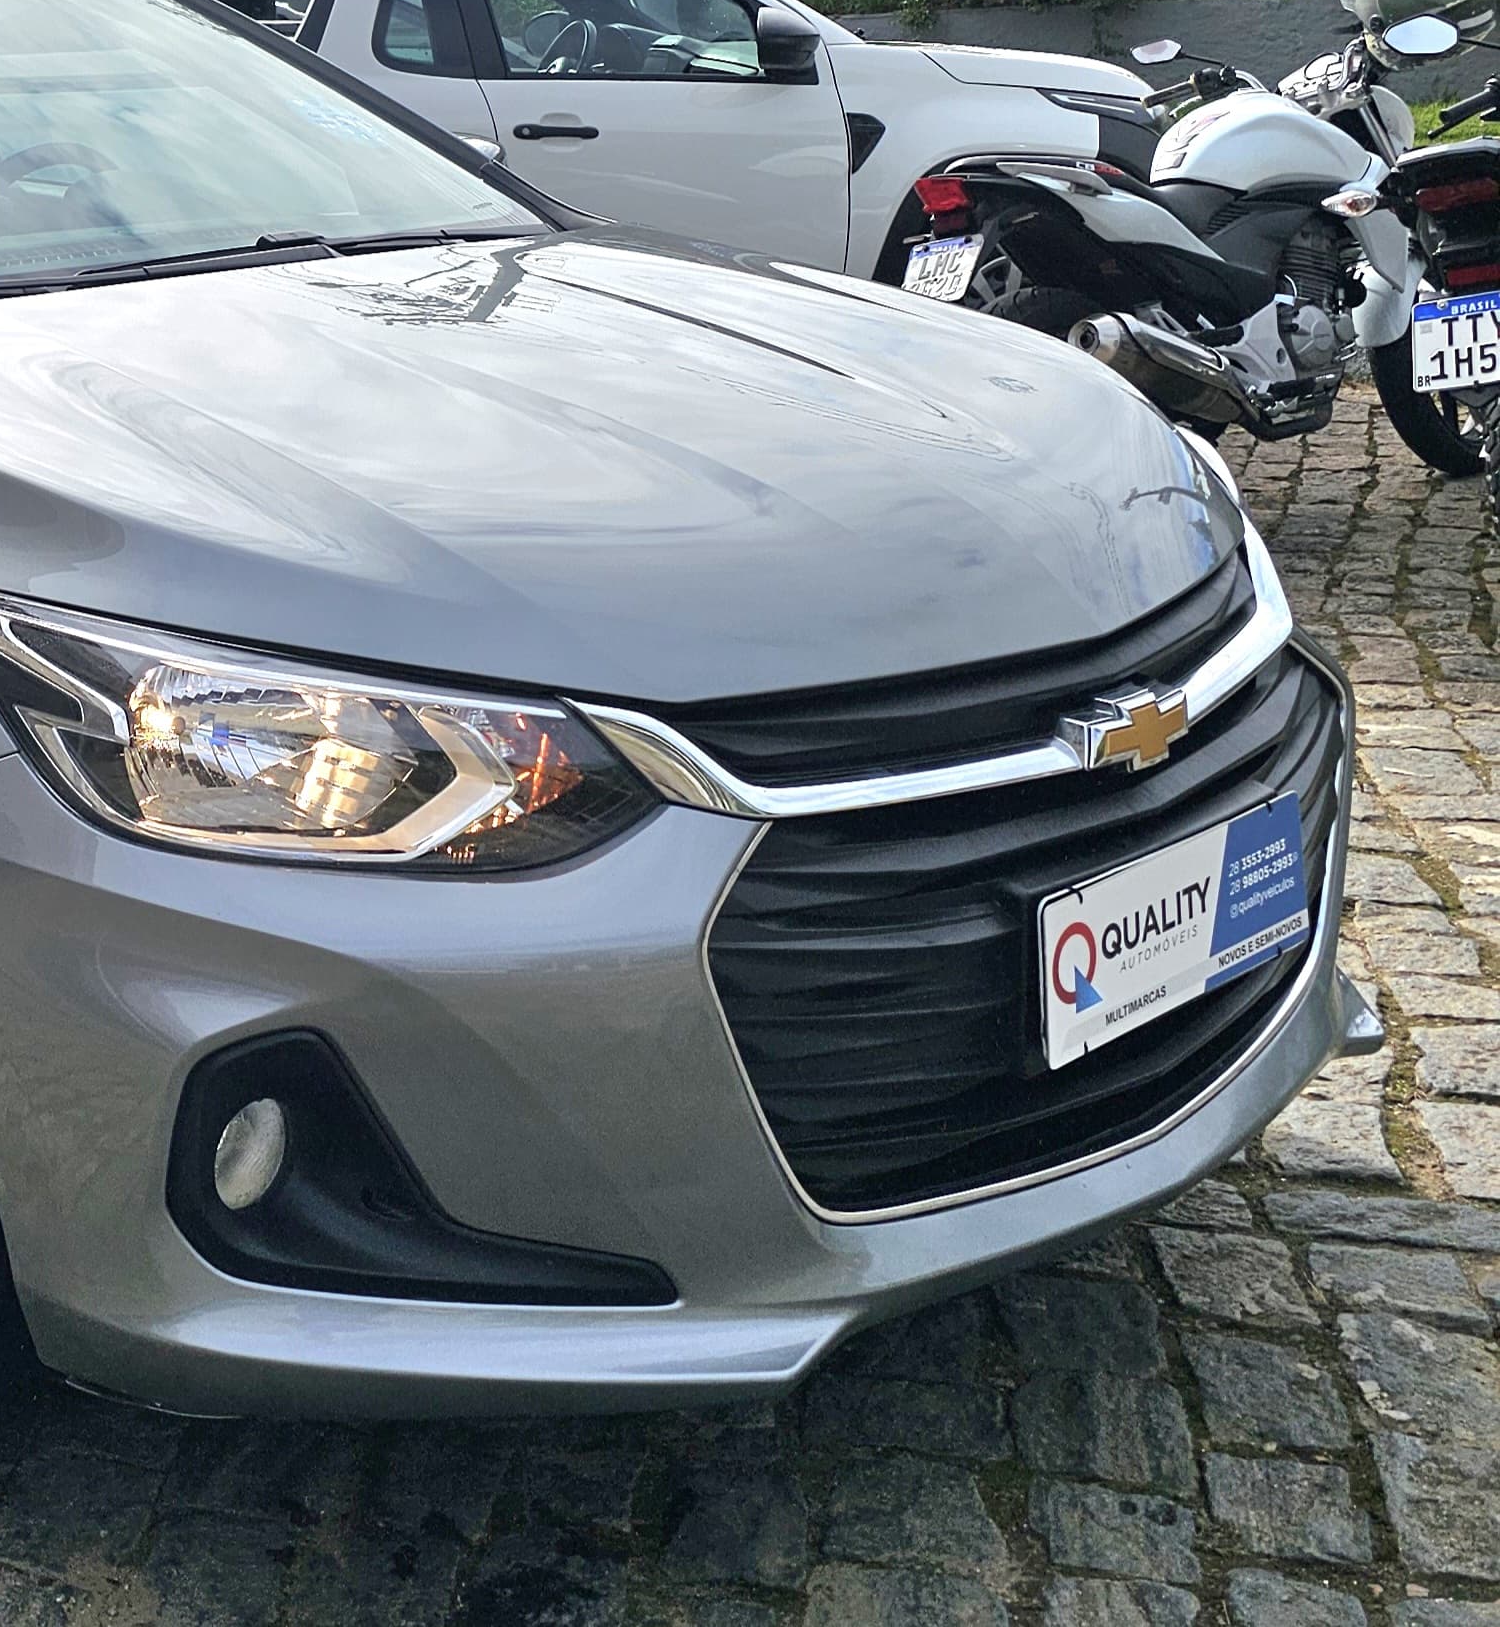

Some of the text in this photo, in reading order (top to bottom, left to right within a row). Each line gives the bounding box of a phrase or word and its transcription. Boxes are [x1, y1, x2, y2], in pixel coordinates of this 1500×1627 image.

[1451, 299, 1497, 315] BRASIL
[1417, 375, 1431, 387] BR
[1430, 343, 1497, 380] 1H5
[1228, 838, 1286, 877] 28 3553-2993
[1229, 853, 1293, 896] 28 98805-2993
[1238, 876, 1295, 915] qualityveiculos
[1101, 876, 1211, 959] QUALITY
[1120, 924, 1198, 973] AUTOMÓVEIS
[1218, 916, 1302, 968] NOVOS E SEMI-NOVOS
[1105, 985, 1167, 1026] MULTIMARCAS
